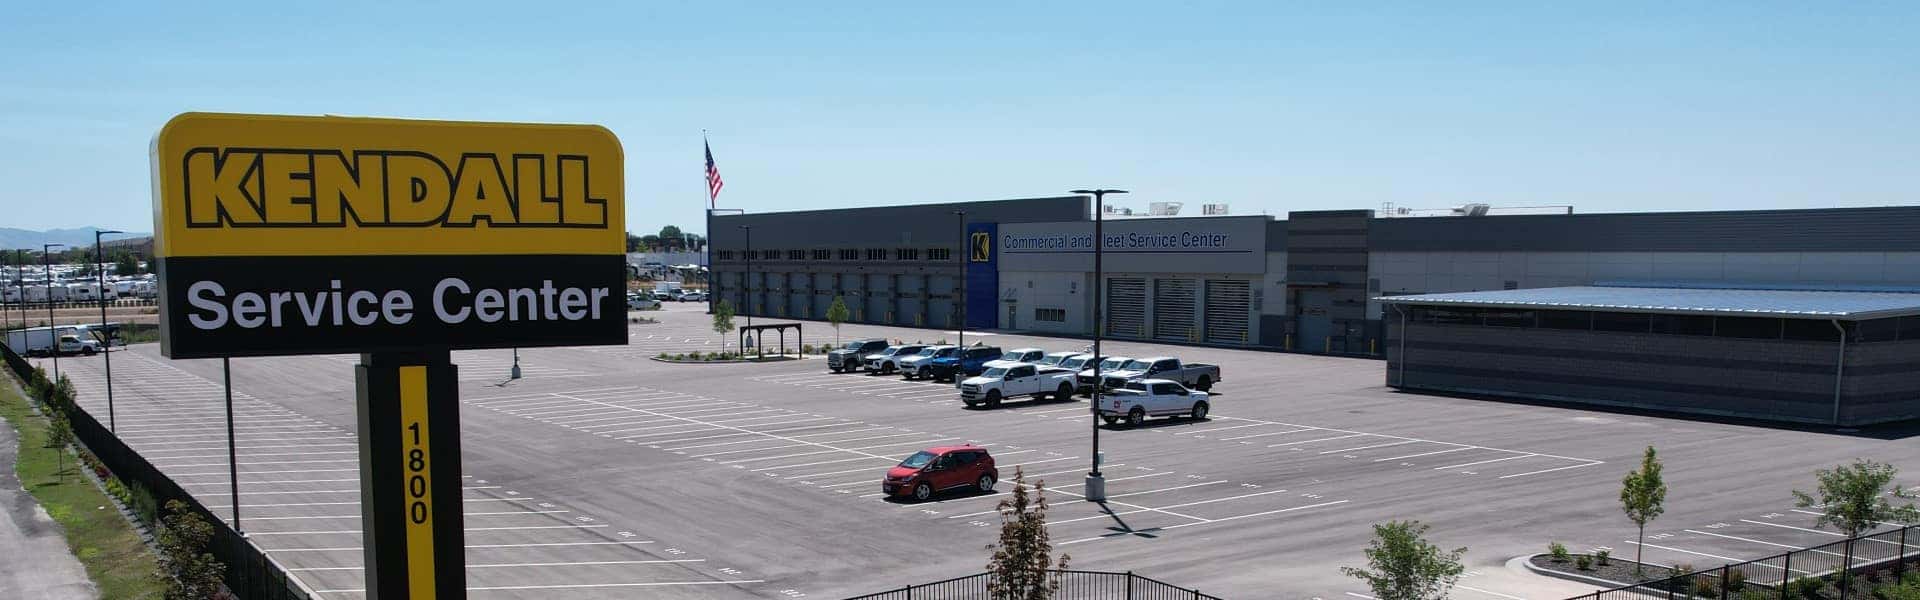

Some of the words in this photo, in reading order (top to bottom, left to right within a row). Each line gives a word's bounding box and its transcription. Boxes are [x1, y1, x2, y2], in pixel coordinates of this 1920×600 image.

[183, 147, 608, 229] KENDALL
[971, 232, 990, 262] K
[1004, 235, 1068, 249] Commercial
[1071, 234, 1092, 248] and
[1098, 233, 1125, 248] leet
[1128, 232, 1177, 248] Service
[1181, 231, 1227, 247] Center
[187, 280, 412, 330] Service
[432, 277, 609, 324] Center
[408, 422, 427, 524] 1800
